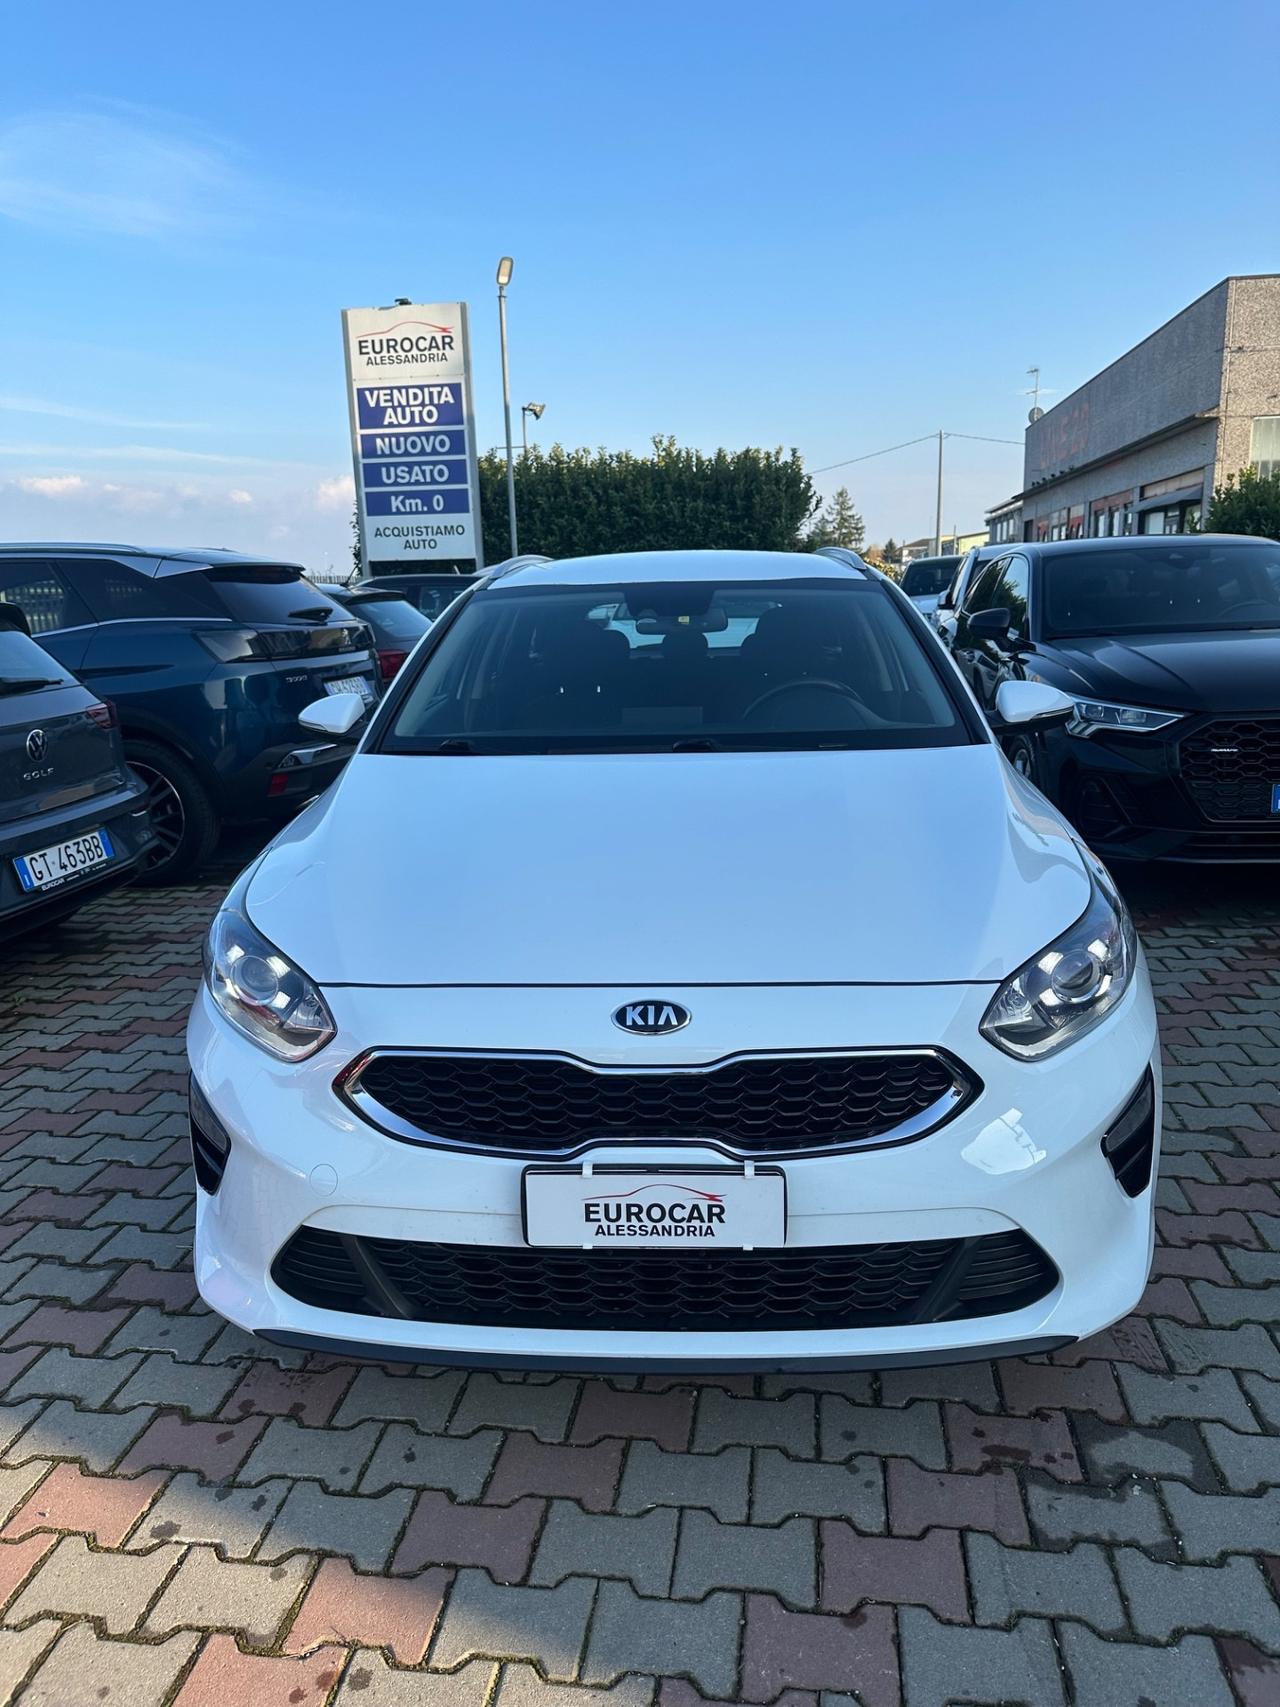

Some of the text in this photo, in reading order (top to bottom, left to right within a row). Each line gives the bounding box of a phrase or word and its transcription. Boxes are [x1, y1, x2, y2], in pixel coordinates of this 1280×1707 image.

[358, 335, 455, 356] EUROCAR
[366, 352, 449, 367] ALESSANDRIA
[364, 386, 455, 408] VENDITA
[383, 406, 439, 426] AUTO
[375, 434, 451, 456] NUOVO
[381, 464, 450, 485] USATO
[390, 494, 444, 514] Km. 0
[374, 524, 465, 539] ACQUISTIAMO
[403, 539, 438, 551] AUTO
[23, 767, 55, 781] GOLF
[29, 834, 104, 882] GT 463BB
[625, 1005, 679, 1026] KIA
[584, 1202, 726, 1224] EUROCAR
[594, 1224, 716, 1237] ALESSANDRIA
